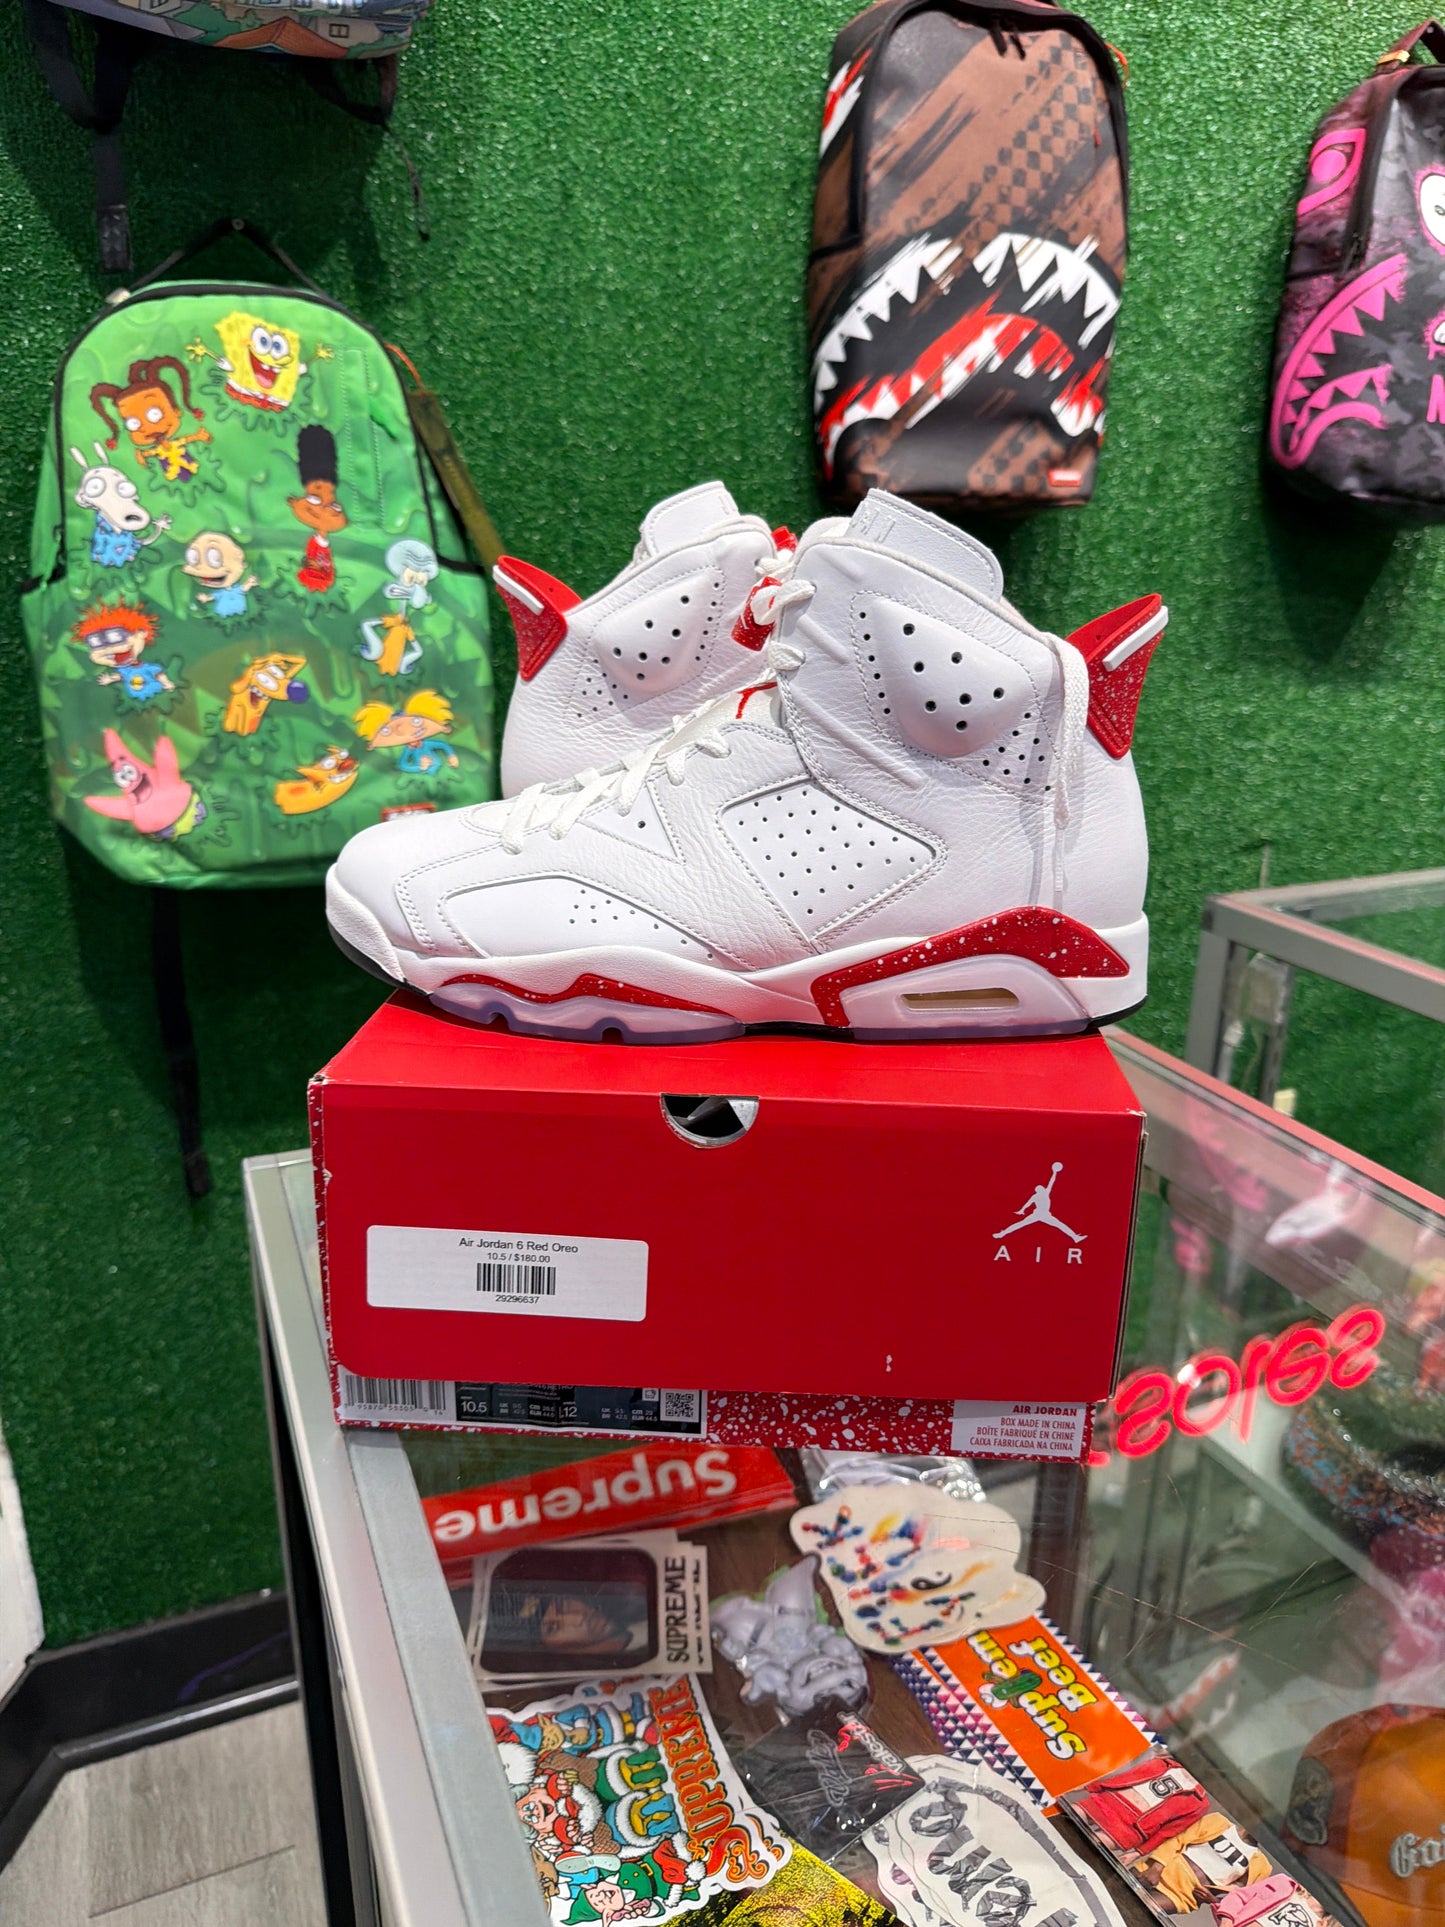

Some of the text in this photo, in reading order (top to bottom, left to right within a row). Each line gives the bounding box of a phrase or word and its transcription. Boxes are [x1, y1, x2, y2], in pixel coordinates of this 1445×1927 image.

[459, 1238, 579, 1253] Air Jordan 6 Red Oreo
[487, 1252, 507, 1261] 10.5
[514, 1253, 550, 1263] $180.00
[994, 1245, 1082, 1264] AIR
[495, 1294, 539, 1304] 29296637
[461, 1401, 487, 1413] 10.5
[1012, 1405, 1077, 1417] AIR JORDAN
[1000, 1417, 1076, 1430] BOX MADE IN CHINA
[1038, 1429, 1049, 1439] EN
[1051, 1431, 1075, 1441] CHINE
[969, 1437, 1073, 1451] CAIXA FABRICADA NA CHINA
[434, 1450, 737, 1542] Supreme
[663, 1555, 690, 1663] SUPREME
[648, 1676, 768, 1882] SUPREME
[1209, 1834, 1249, 1868] UP
